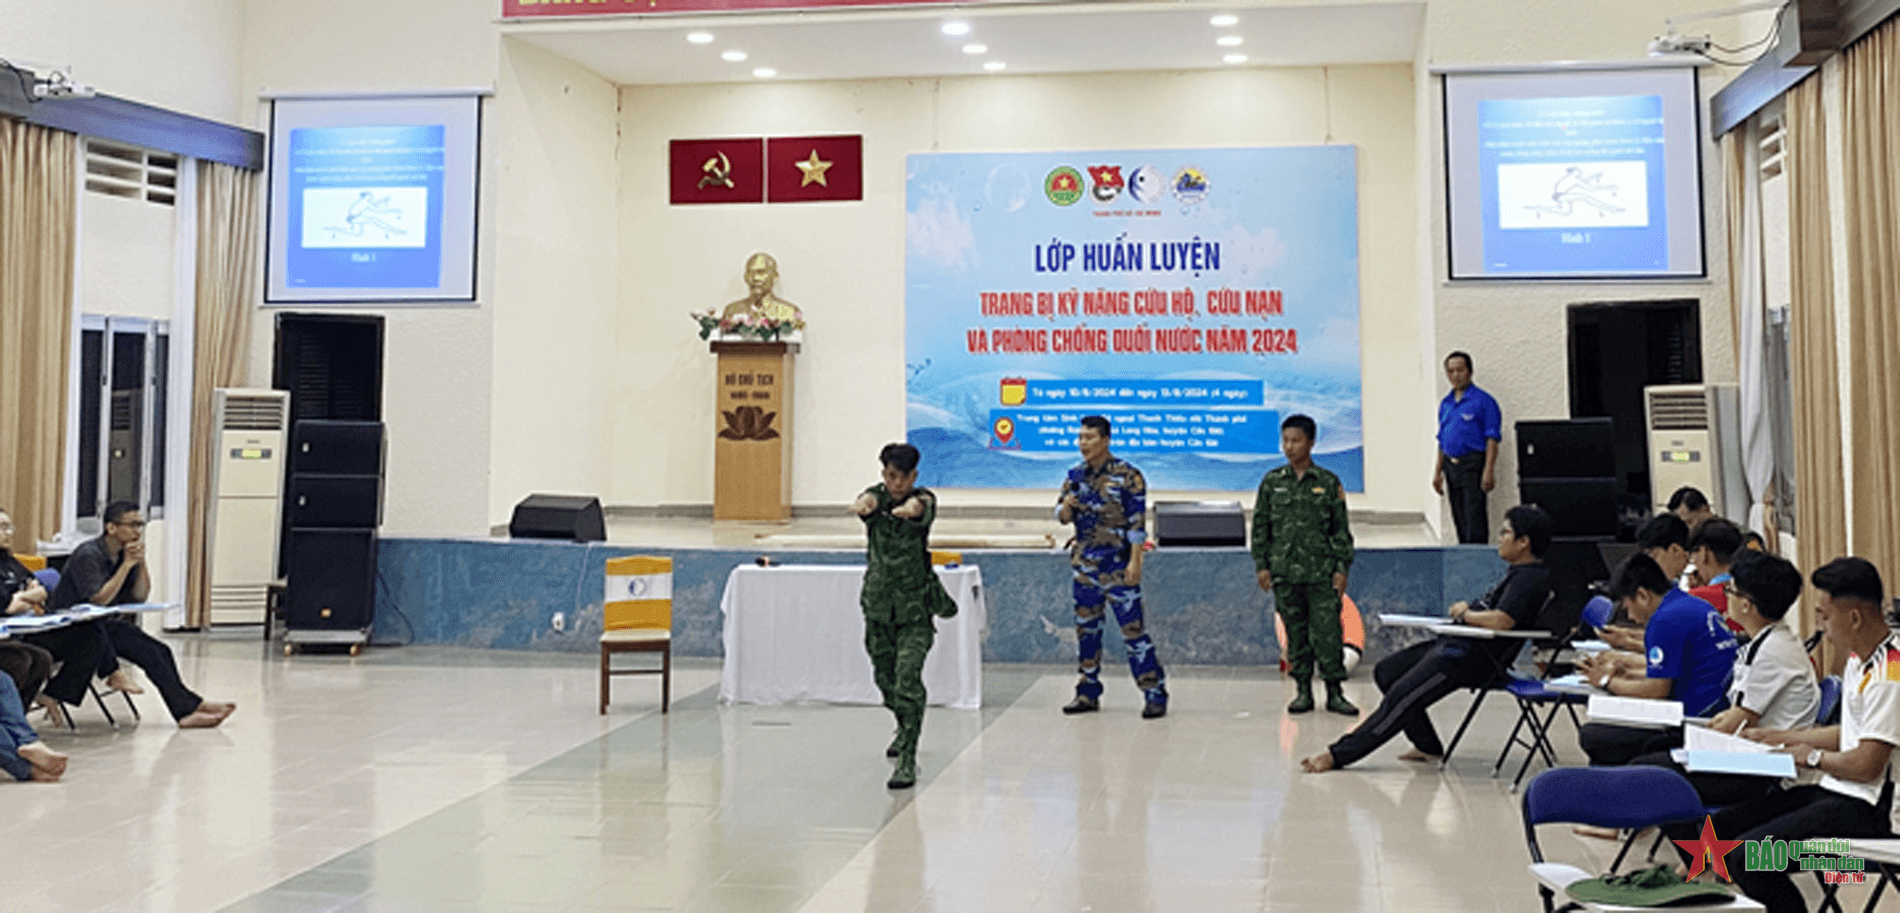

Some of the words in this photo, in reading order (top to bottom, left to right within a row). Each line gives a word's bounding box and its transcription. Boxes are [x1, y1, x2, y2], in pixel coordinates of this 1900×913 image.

[1035, 238, 1075, 272] LỚP
[1084, 232, 1143, 272] HUẤN
[1151, 235, 1220, 278] LUYỆN
[980, 292, 1033, 316] TRANG
[1037, 292, 1054, 321] BỊ
[1057, 287, 1079, 315] KỸ
[1083, 287, 1130, 315] NĂNG
[1134, 287, 1168, 315] CỨU
[1207, 286, 1242, 314] CỨU
[1245, 290, 1284, 320] NẠN
[966, 326, 988, 354] VÀ
[992, 326, 1048, 354] PHÒNG
[1052, 321, 1108, 354] CHỐNG
[1155, 325, 1202, 354] NƯỚC
[1205, 324, 1248, 354] NĂM
[1252, 328, 1297, 354] 2024
